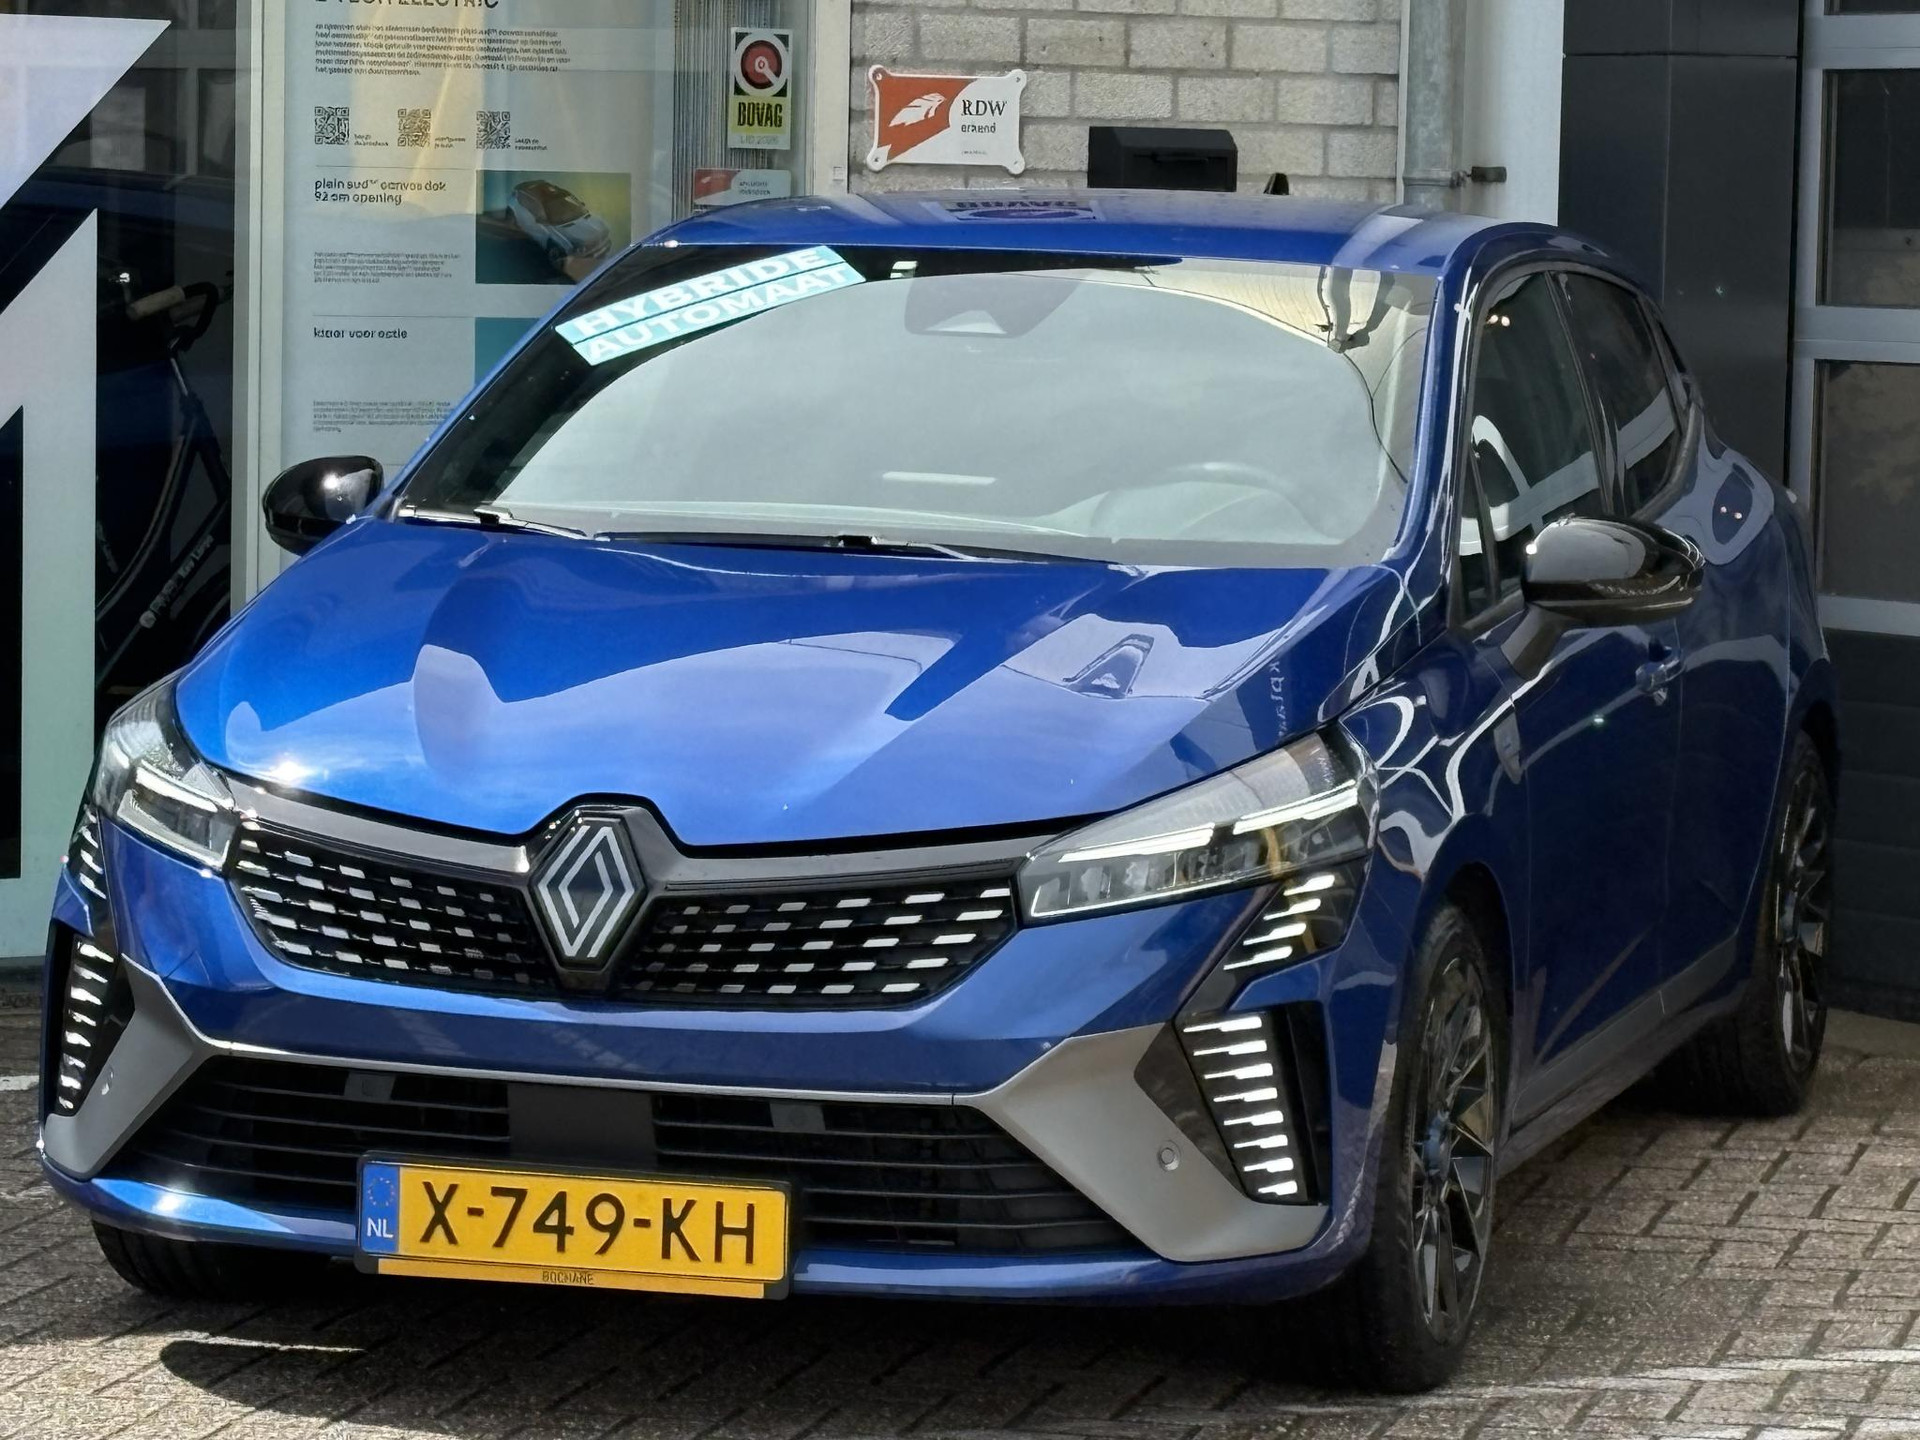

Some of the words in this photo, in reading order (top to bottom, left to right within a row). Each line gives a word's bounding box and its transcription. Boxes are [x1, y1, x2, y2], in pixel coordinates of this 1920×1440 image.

[737, 102, 783, 128] BOVAG
[961, 99, 1007, 117] RDW
[352, 193, 402, 205] opening
[574, 250, 826, 336] HYBRIDE
[587, 268, 847, 359] AUTOMAAT
[348, 329, 376, 339] voor
[367, 1217, 394, 1239] NL
[419, 1180, 756, 1265] X-749-KH
